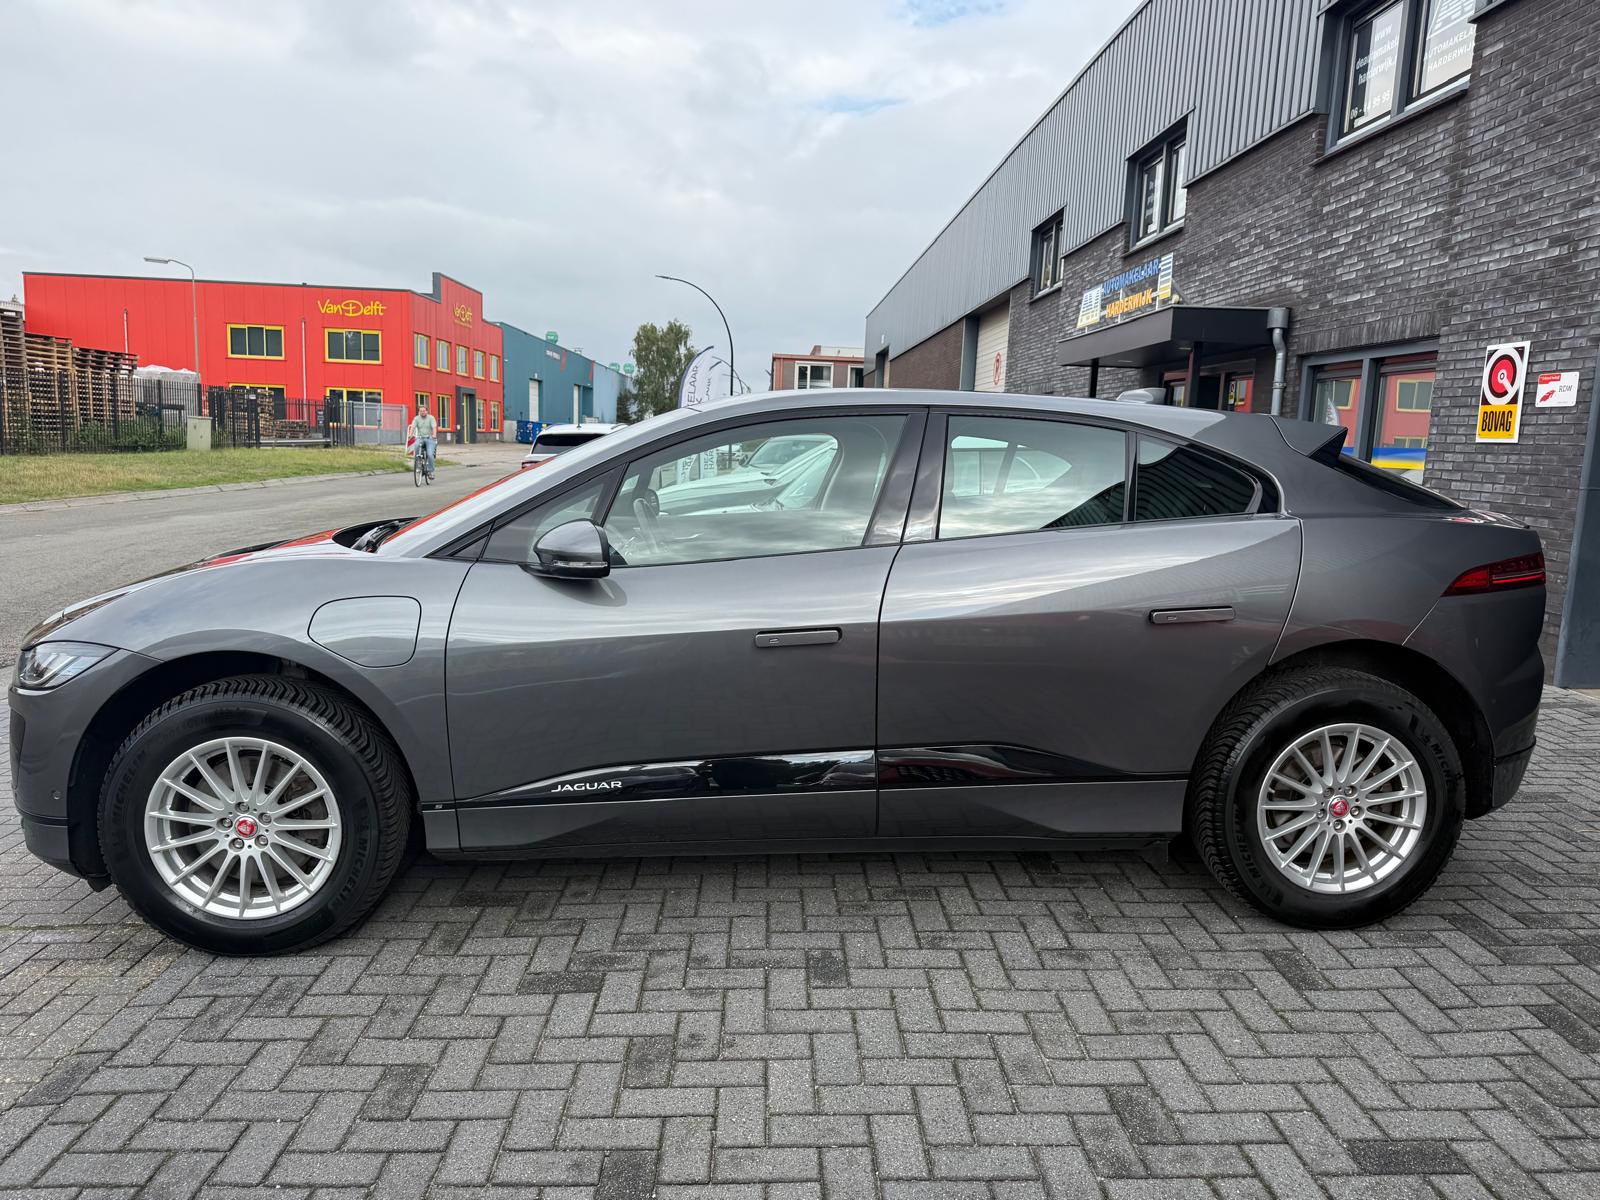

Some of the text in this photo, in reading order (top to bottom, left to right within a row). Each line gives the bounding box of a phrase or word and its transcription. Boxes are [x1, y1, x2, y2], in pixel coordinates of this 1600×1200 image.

[1102, 258, 1160, 296] AUTOMAKELAAR
[1106, 288, 1154, 319] HARDERWIJK
[1481, 410, 1512, 432] BOVAG
[551, 781, 622, 793] JAGUAR
